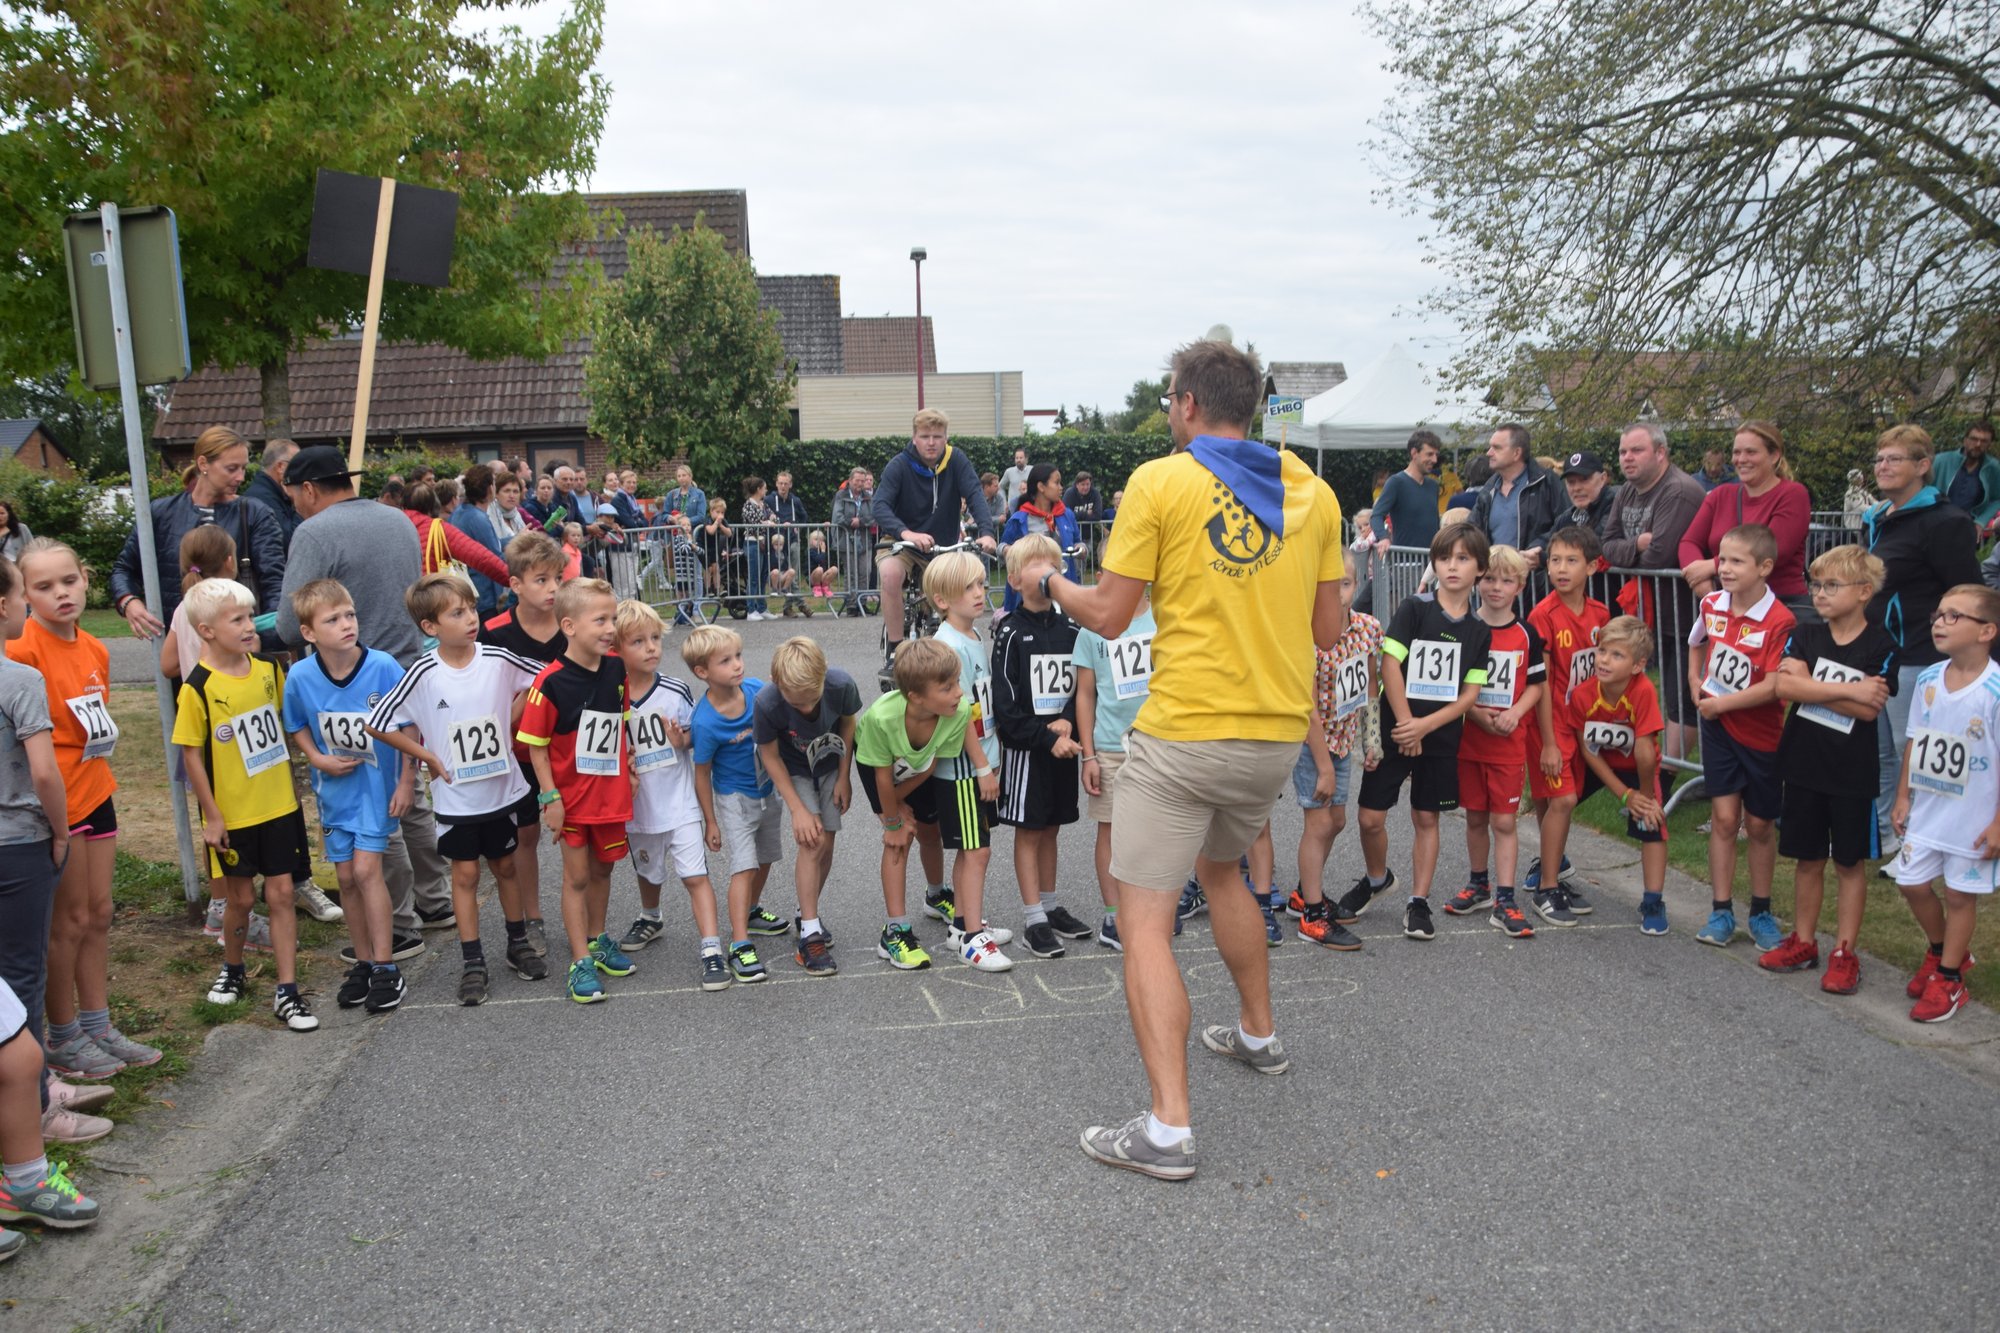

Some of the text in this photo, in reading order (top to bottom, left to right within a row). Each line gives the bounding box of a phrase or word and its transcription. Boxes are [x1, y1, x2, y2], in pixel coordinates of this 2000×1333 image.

[1270, 401, 1302, 416] EHBO
[1556, 629, 1573, 648] 10
[1034, 660, 1073, 694] 125
[1338, 660, 1367, 701] 126
[1416, 646, 1455, 681] 131
[1572, 652, 1595, 686] 138
[1715, 649, 1749, 691] 132
[75, 700, 113, 740] 227
[238, 709, 278, 753] 130
[324, 717, 367, 750] 133
[585, 716, 619, 754] 121
[453, 722, 500, 763] 123
[1917, 734, 1965, 779] 139
